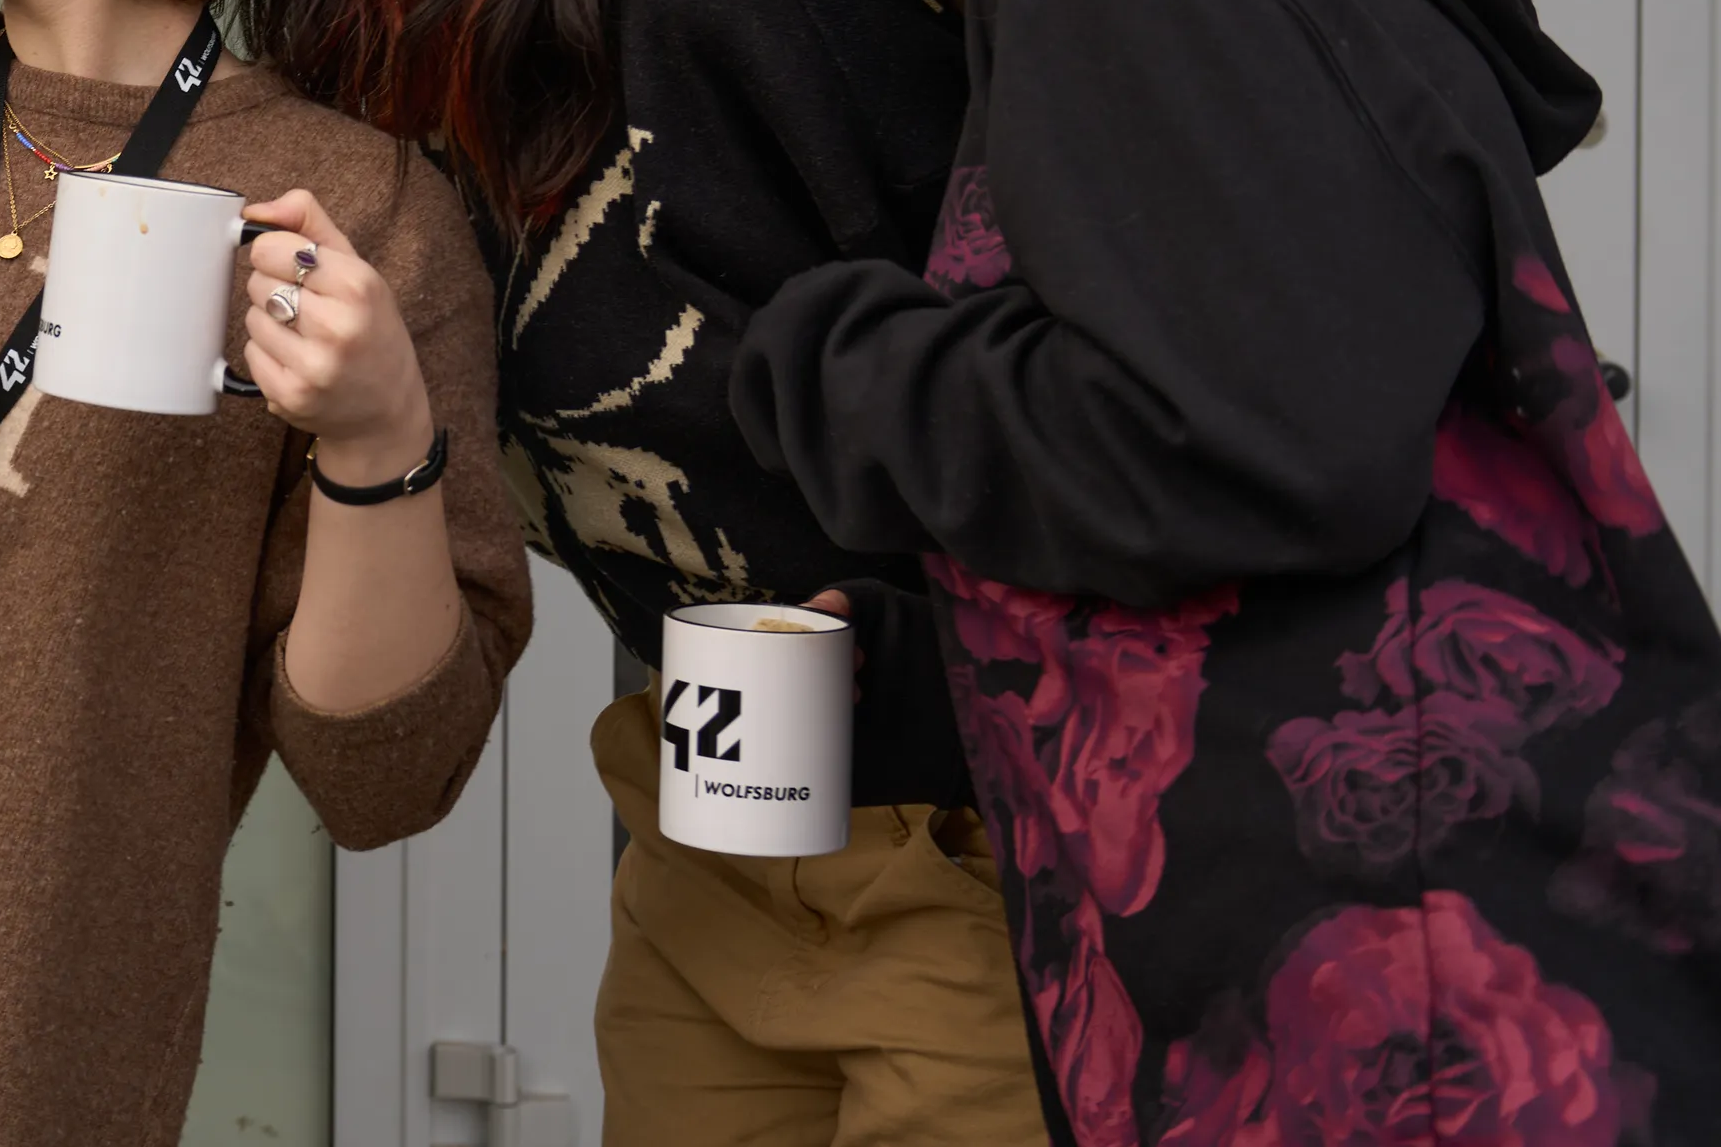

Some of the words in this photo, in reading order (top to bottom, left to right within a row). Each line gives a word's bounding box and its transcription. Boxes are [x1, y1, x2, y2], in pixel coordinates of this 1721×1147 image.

[174, 57, 203, 93] 42
[661, 678, 743, 773] 42
[704, 779, 812, 802] WOLFSBURG
